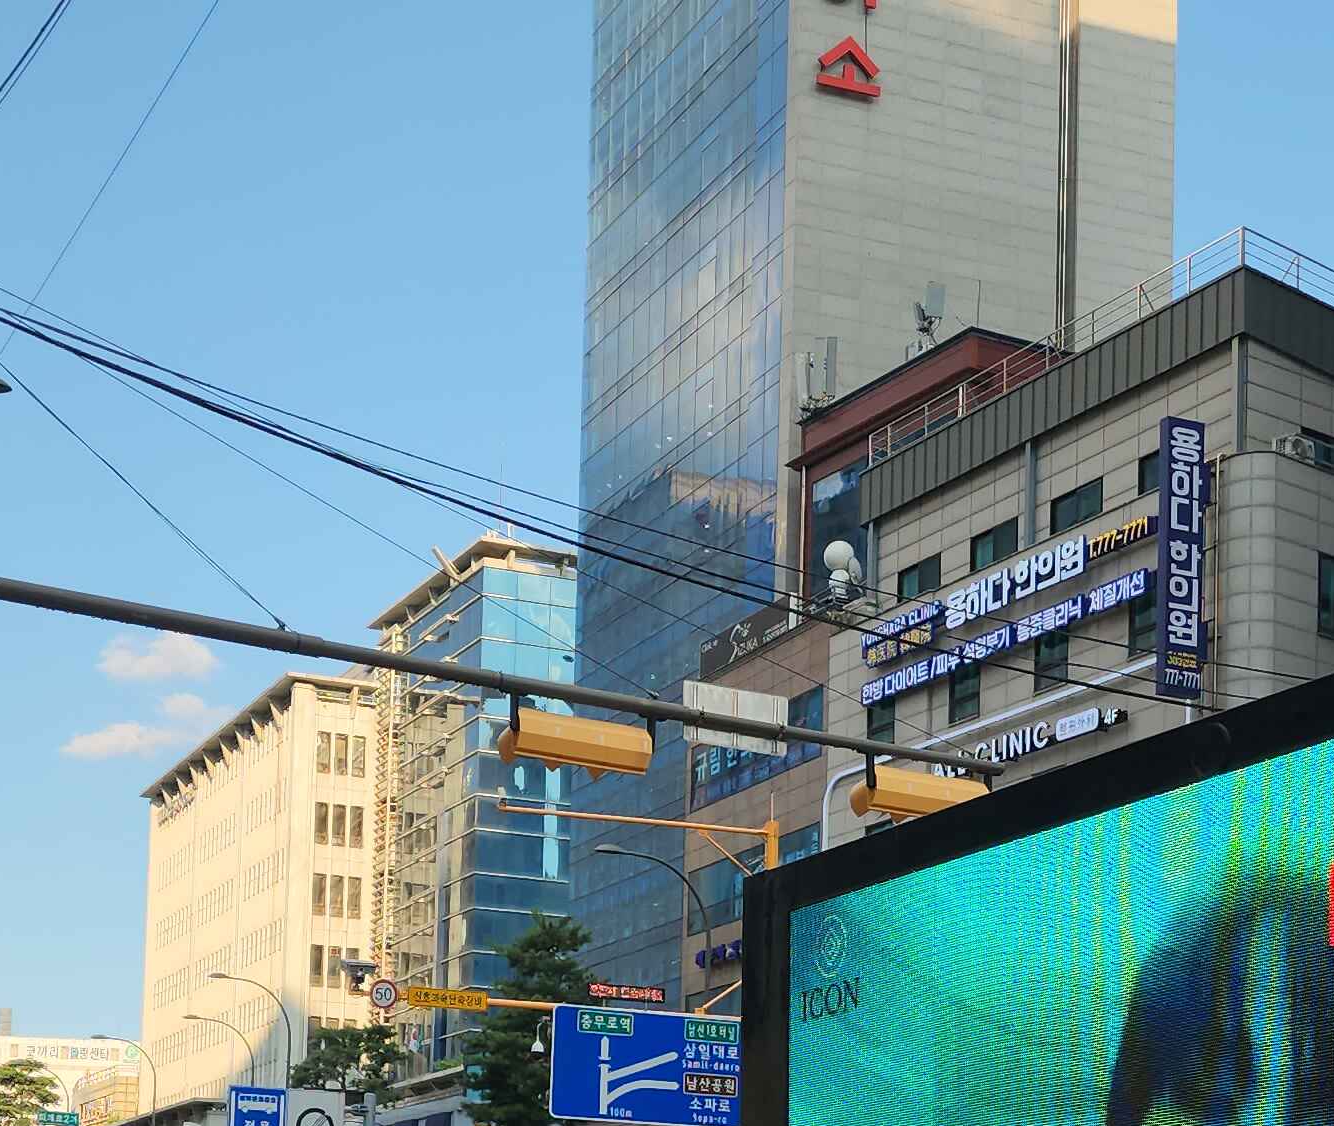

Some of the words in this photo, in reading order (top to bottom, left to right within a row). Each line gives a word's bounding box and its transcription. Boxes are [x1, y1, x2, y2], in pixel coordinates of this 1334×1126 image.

[1170, 426, 1203, 533] 용하다
[945, 567, 1010, 630] 용하다
[1014, 534, 1084, 599] 한의원
[1168, 540, 1202, 647] 한의원
[974, 721, 1051, 763] CLINIC
[375, 987, 392, 1001] 50
[799, 978, 860, 1022] ICON
[580, 1014, 631, 1034] 충무로역
[687, 1023, 736, 1042] 남산1호터널
[683, 1043, 739, 1060] 삼일대로
[686, 1075, 735, 1094] 남산공원
[689, 1098, 731, 1113] 소파로
